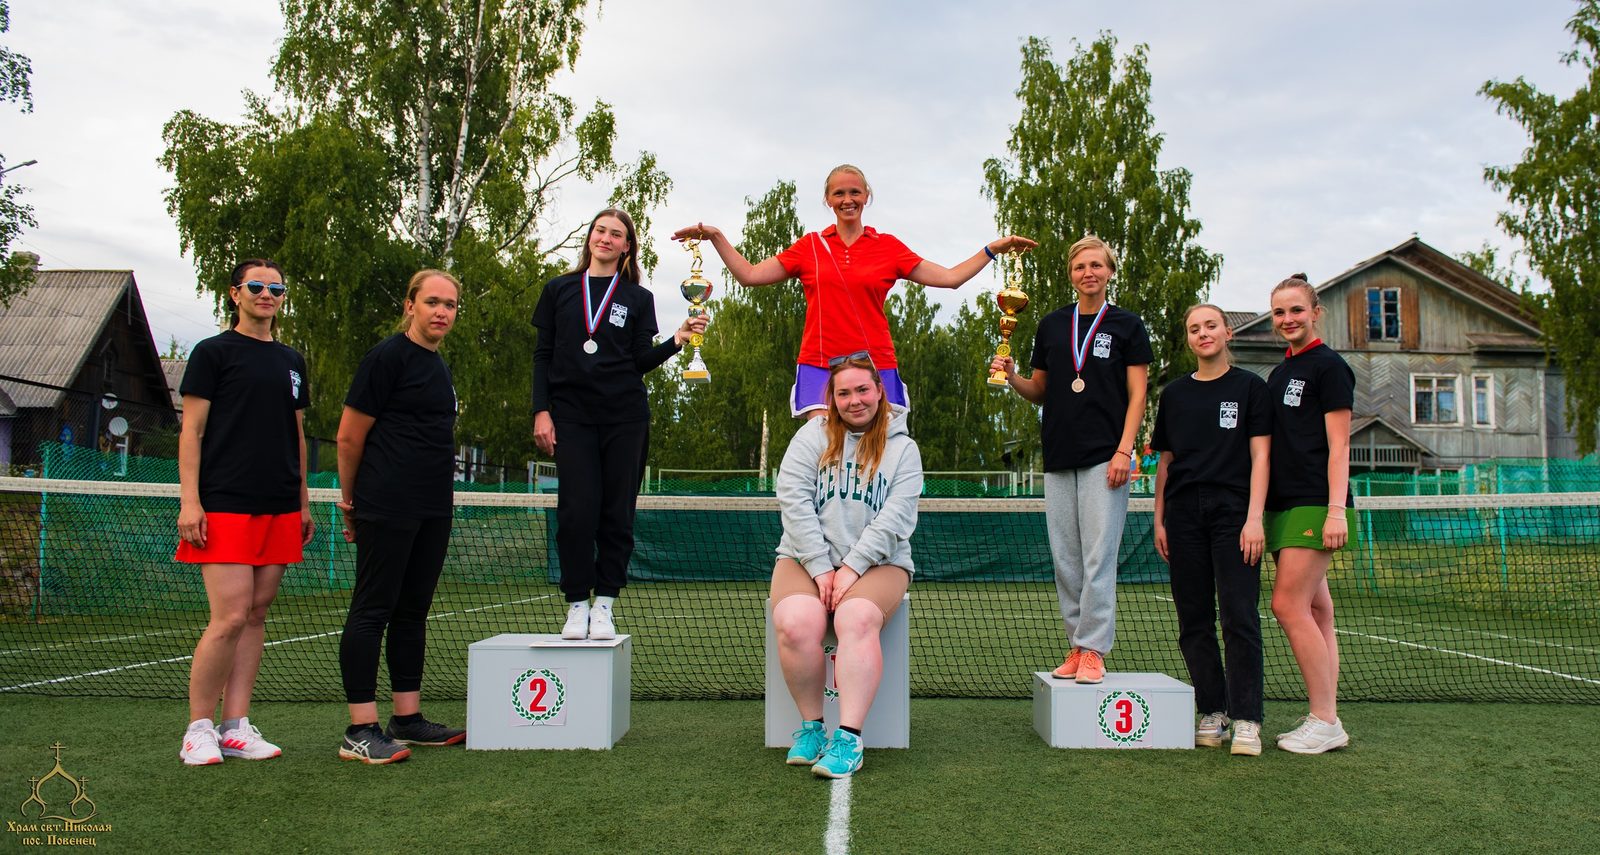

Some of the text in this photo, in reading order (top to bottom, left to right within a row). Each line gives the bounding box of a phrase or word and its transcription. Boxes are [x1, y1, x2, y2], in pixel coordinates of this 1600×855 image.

[839, 461, 889, 514] JEAN
[529, 678, 547, 712] 2
[1115, 699, 1133, 734] 3
